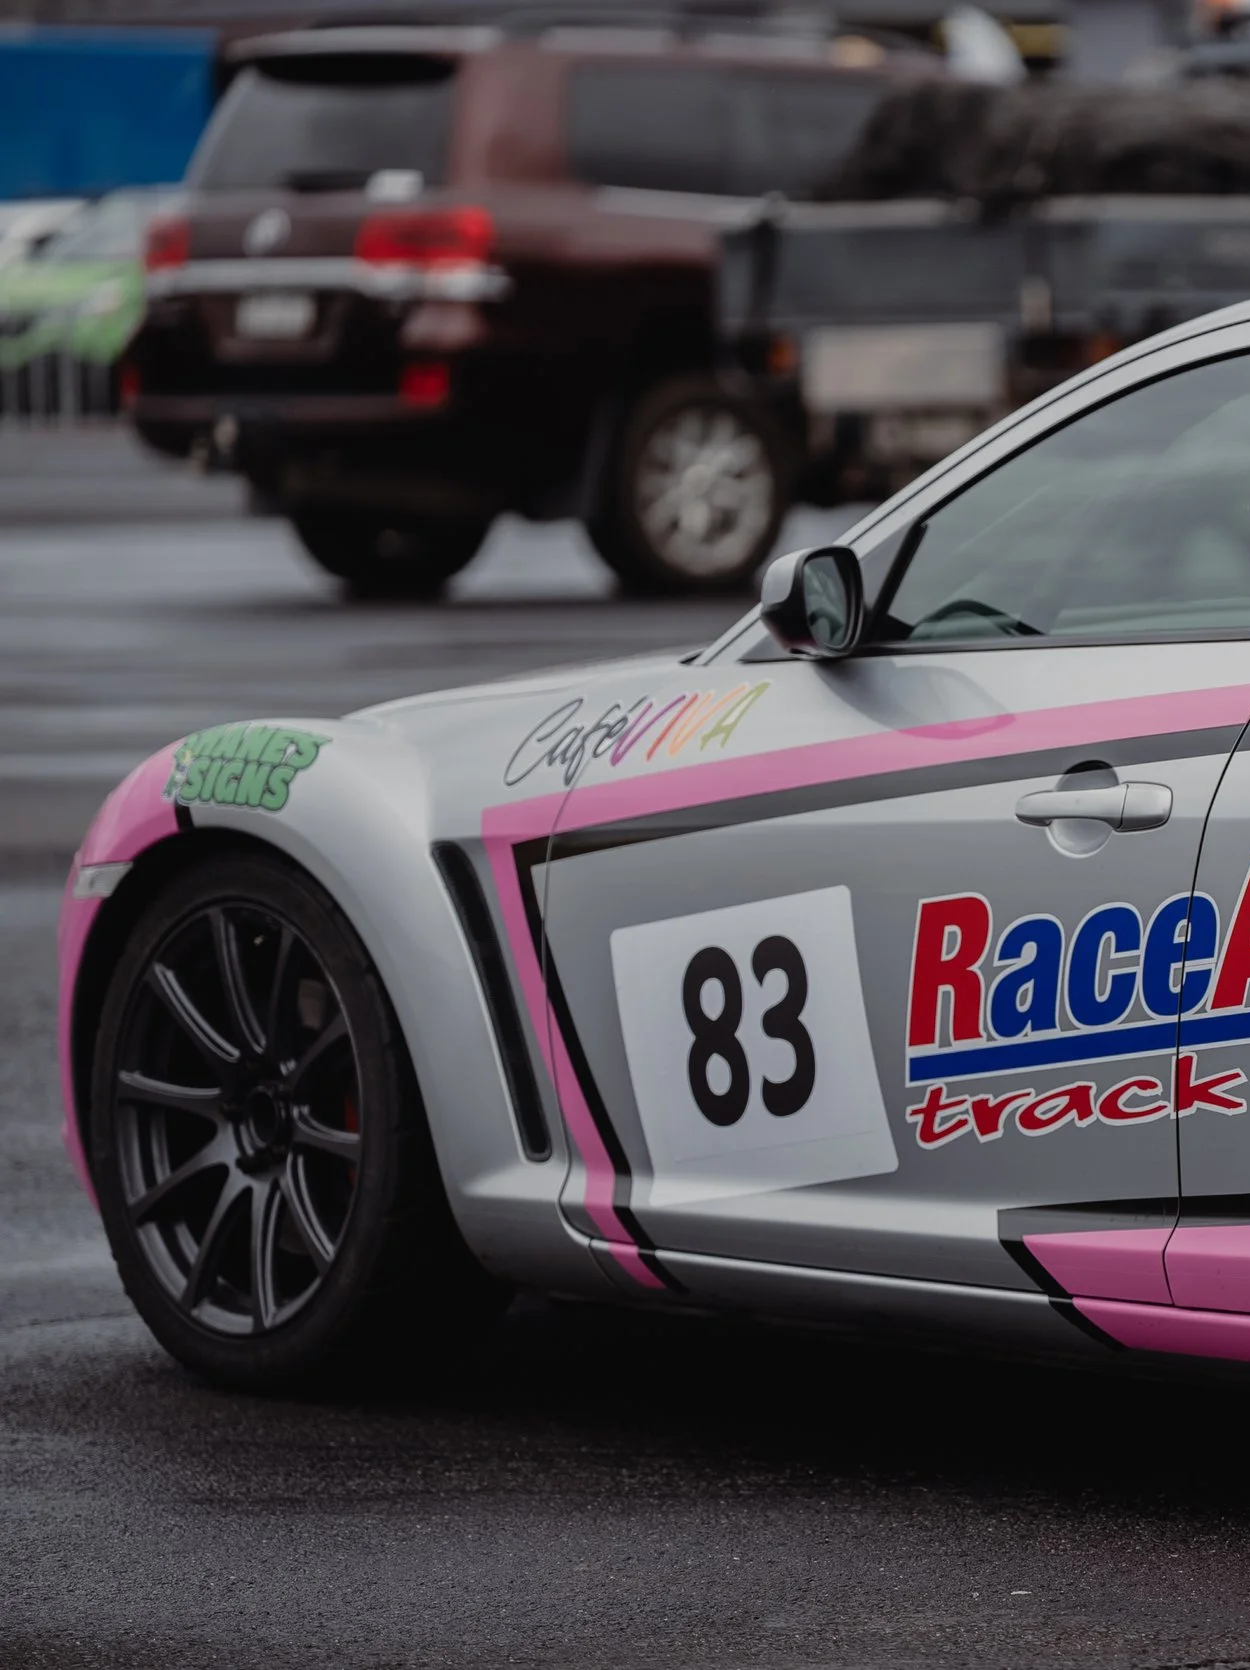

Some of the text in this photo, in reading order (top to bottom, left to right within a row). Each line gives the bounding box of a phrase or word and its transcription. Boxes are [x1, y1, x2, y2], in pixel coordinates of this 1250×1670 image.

[610, 679, 771, 766] VIVA
[178, 757, 299, 812] SIGNS
[682, 933, 817, 1128] 83
[906, 1049, 1247, 1151] track
